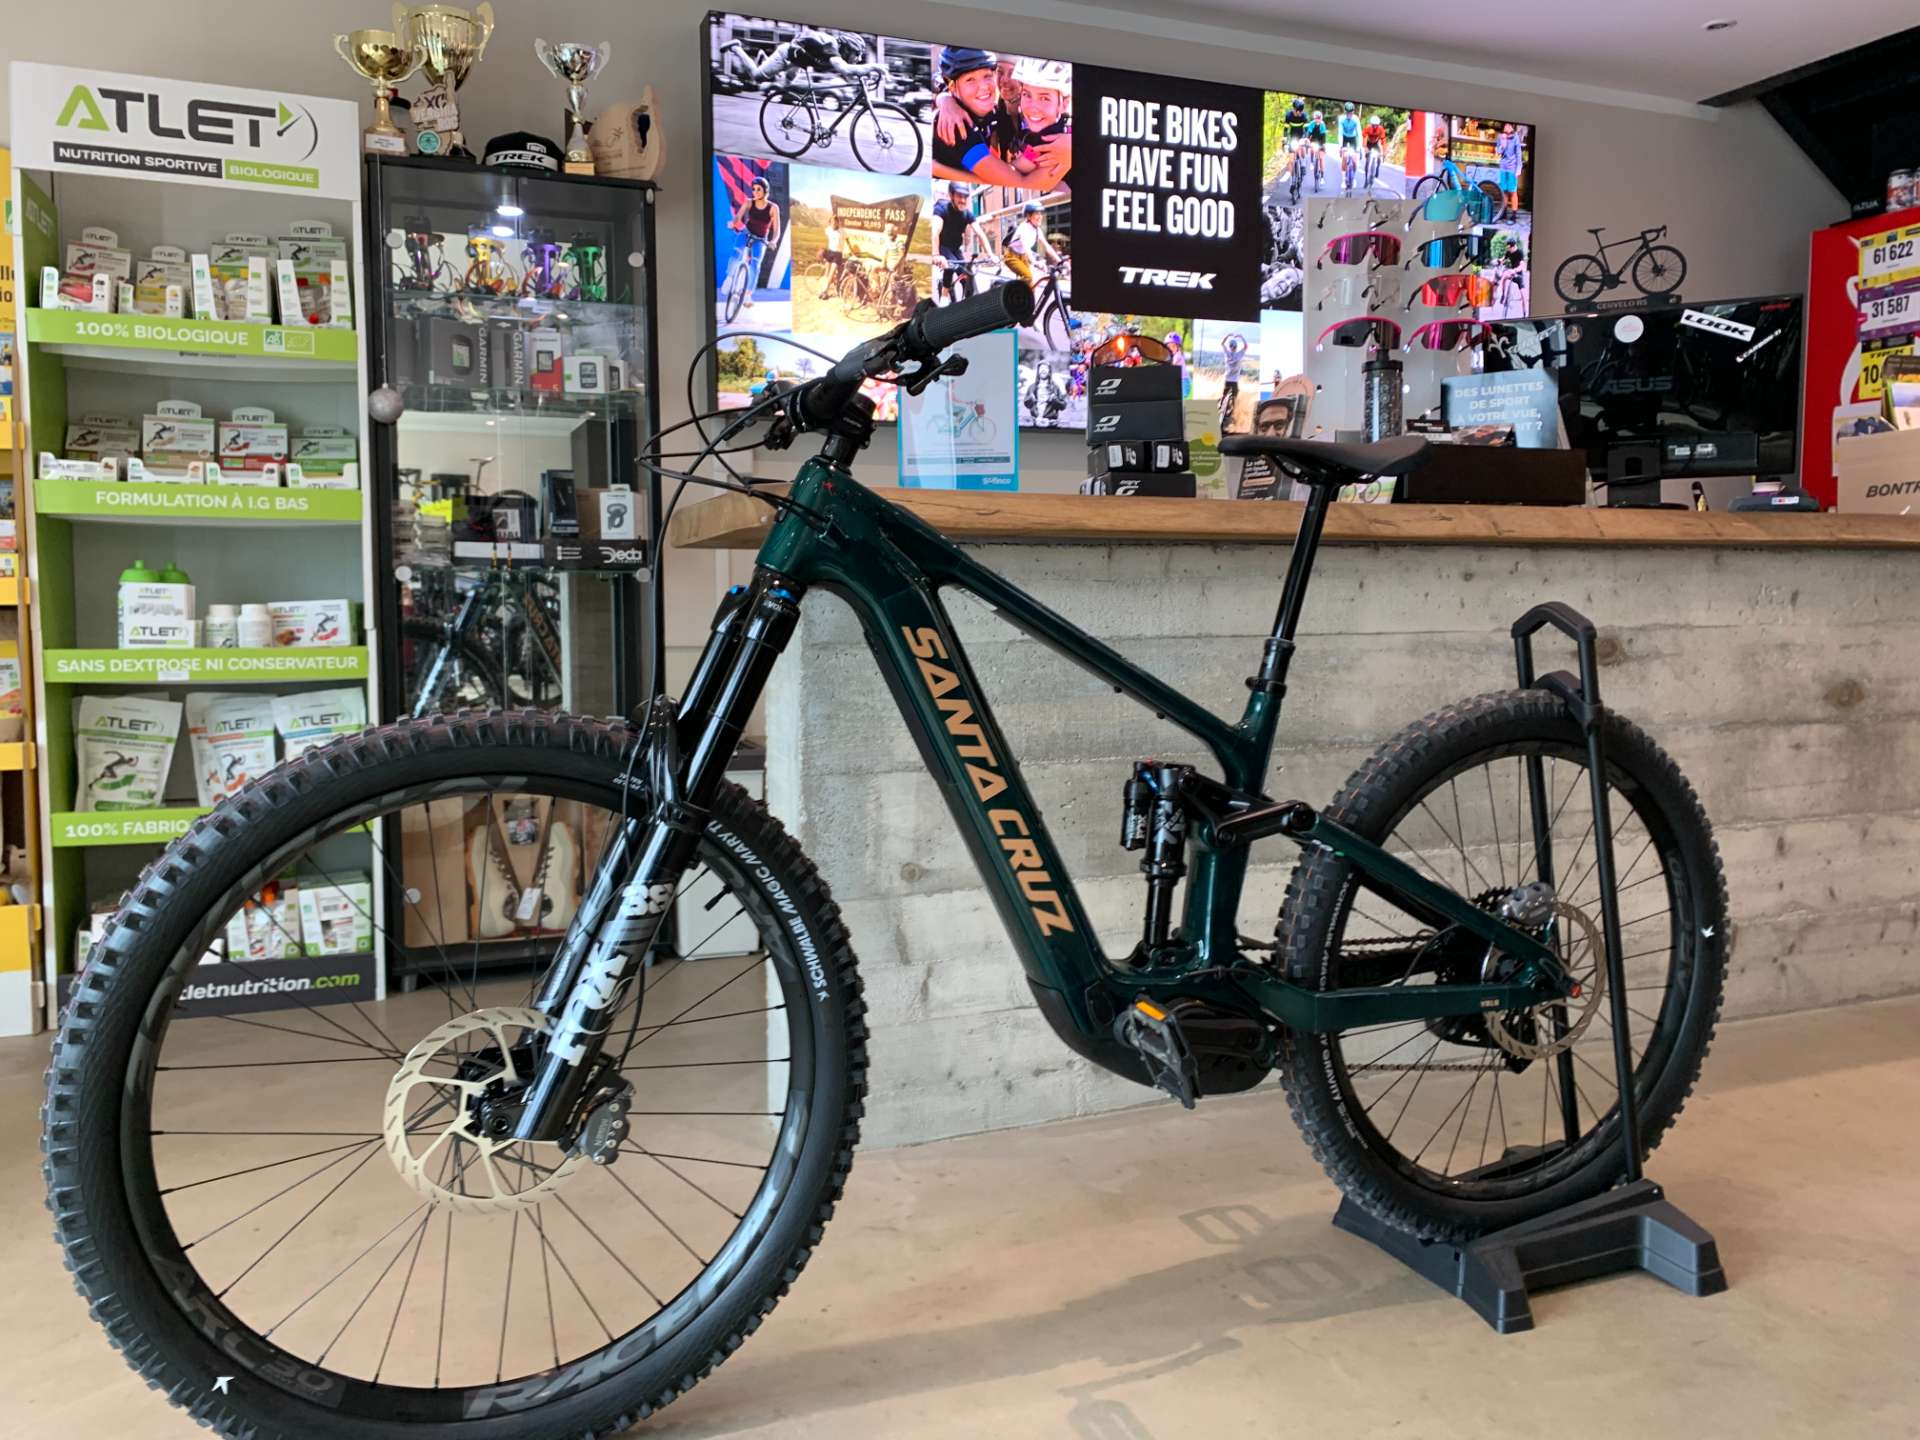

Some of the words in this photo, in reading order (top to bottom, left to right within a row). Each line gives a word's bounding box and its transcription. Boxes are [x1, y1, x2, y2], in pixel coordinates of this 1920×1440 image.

[56, 84, 277, 148] ATLET
[1101, 96, 1160, 144] RIDE
[1166, 107, 1238, 151] BIKES
[59, 147, 141, 166] NUTRITION
[144, 154, 218, 174] SPORTIVE
[229, 165, 315, 184] BIOLOGIQUE
[493, 153, 545, 164] TREK
[1109, 143, 1173, 188] HAVE
[1179, 150, 1229, 194] FUN
[838, 206, 881, 220] INDEPENDENCE
[885, 208, 906, 221] PASS
[1101, 189, 1160, 233] FEEL
[1167, 195, 1235, 239] GOOD
[1873, 247, 1887, 265] 61
[1889, 240, 1914, 261] 622
[1118, 266, 1217, 290] TREK
[1872, 301, 1885, 318] 31
[1888, 296, 1910, 315] 587
[76, 321, 129, 338] 100%
[134, 323, 249, 346] BIOLOGIQUE
[1683, 314, 1750, 338] LOOK
[478, 327, 488, 384] GARMIN
[513, 332, 524, 385] GARMIN
[1600, 376, 1673, 395] ASUS
[1863, 364, 1882, 385] 10
[1455, 387, 1478, 397] DES
[1481, 381, 1544, 396] LUNETTES
[1470, 399, 1487, 409] DE
[1489, 396, 1530, 408] SPORT
[1470, 411, 1507, 423] VOTRE
[96, 491, 227, 509] FORMULATION
[231, 490, 243, 510] À
[276, 496, 309, 511] BAS
[599, 546, 642, 563] Deda
[130, 625, 180, 637] ATLET
[57, 659, 105, 673] SANS
[111, 658, 202, 673] DEXTROSE
[207, 658, 224, 671] NI
[228, 655, 359, 672] CONSERVATEUR
[95, 715, 153, 732] ATLET
[215, 717, 254, 732] ATLET
[290, 713, 342, 730] ATLET
[901, 625, 1008, 802] SANTA
[988, 808, 1075, 937] CRUZ
[65, 822, 118, 838] 100%
[717, 832, 763, 865] MARY
[756, 866, 798, 915] MAGIC
[788, 917, 829, 988] SCHWALBE
[1322, 1050, 1343, 1101] GRAVITY
